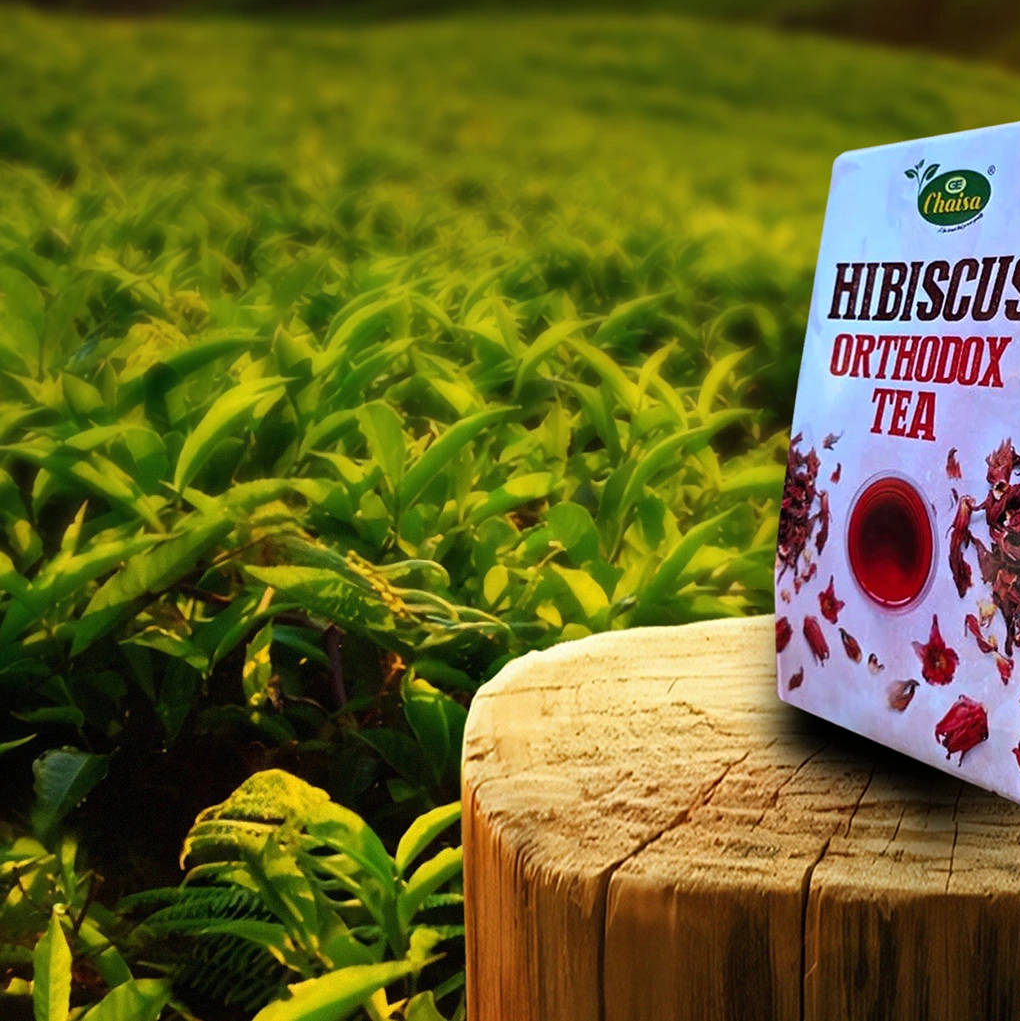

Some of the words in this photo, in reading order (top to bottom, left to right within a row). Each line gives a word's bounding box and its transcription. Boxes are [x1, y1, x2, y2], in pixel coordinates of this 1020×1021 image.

[923, 192, 982, 214] Chaisa
[830, 334, 1012, 388] ORTHODOX
[870, 388, 936, 441] TEA
